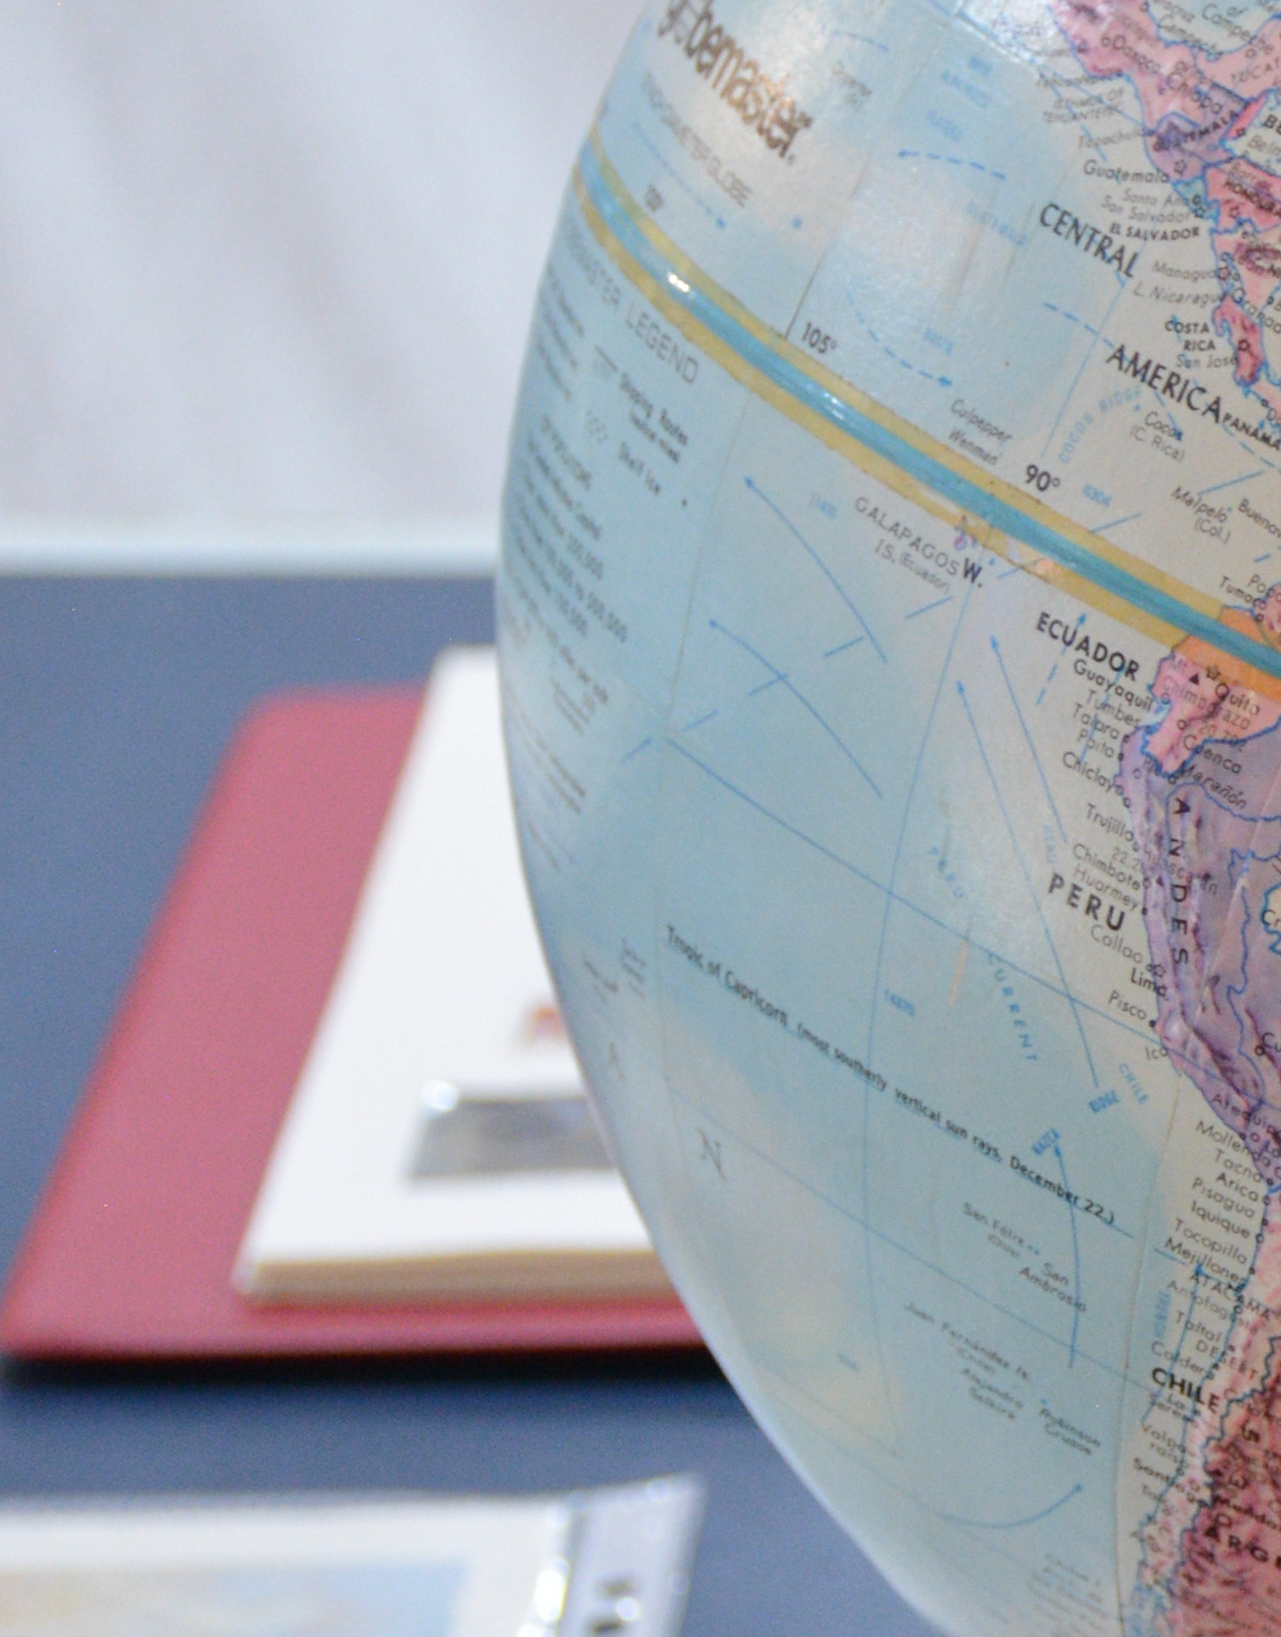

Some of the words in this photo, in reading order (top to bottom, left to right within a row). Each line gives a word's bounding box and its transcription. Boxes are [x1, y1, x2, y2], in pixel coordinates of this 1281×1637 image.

[1038, 203, 1138, 279] CENTRAL
[802, 322, 838, 356] 105°
[1105, 343, 1223, 426] AMERICA
[1024, 464, 1062, 493] 90°
[1035, 611, 1141, 682] ECUADOR
[1048, 872, 1127, 932] PERU
[1007, 1154, 1081, 1208] December
